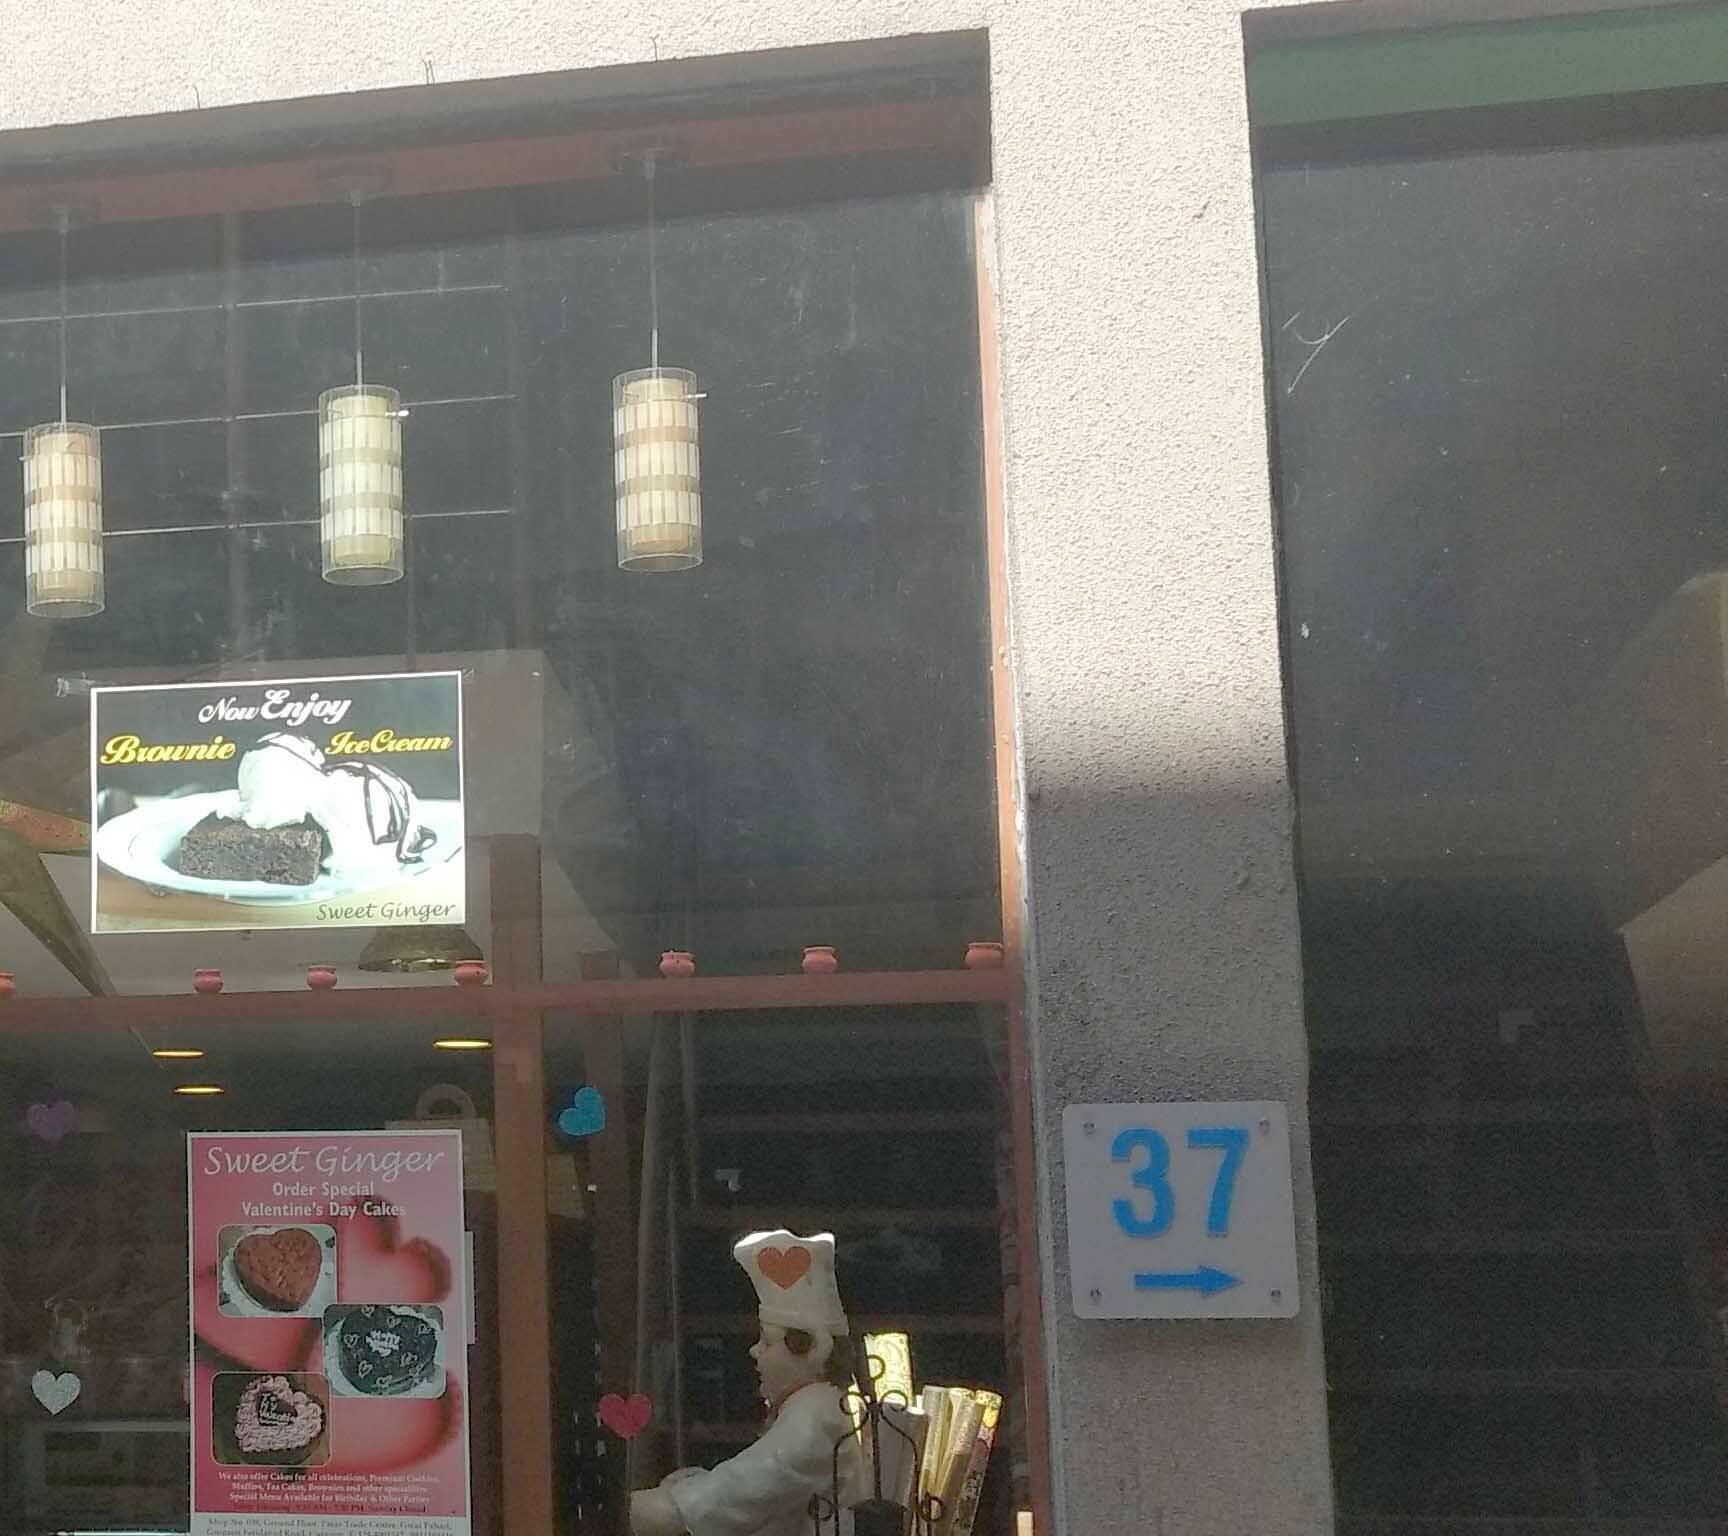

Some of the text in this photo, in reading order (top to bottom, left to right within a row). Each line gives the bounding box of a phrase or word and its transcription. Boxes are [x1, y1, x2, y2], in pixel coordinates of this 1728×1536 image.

[198, 689, 352, 727] Now Enjoy
[100, 734, 237, 766] Brownie
[316, 900, 456, 922] Sweet Ginger
[203, 1145, 446, 1184] Sweet Ginger
[271, 1180, 375, 1200] Order Special
[1110, 1127, 1250, 1241] 37
[240, 1200, 407, 1221] Valentine's Day Cakes
[218, 1471, 231, 1481] We
[270, 1472, 294, 1482] Cakes
[295, 1472, 306, 1482] for
[307, 1472, 318, 1482] all
[229, 1493, 258, 1503] Special
[346, 1484, 361, 1493] and
